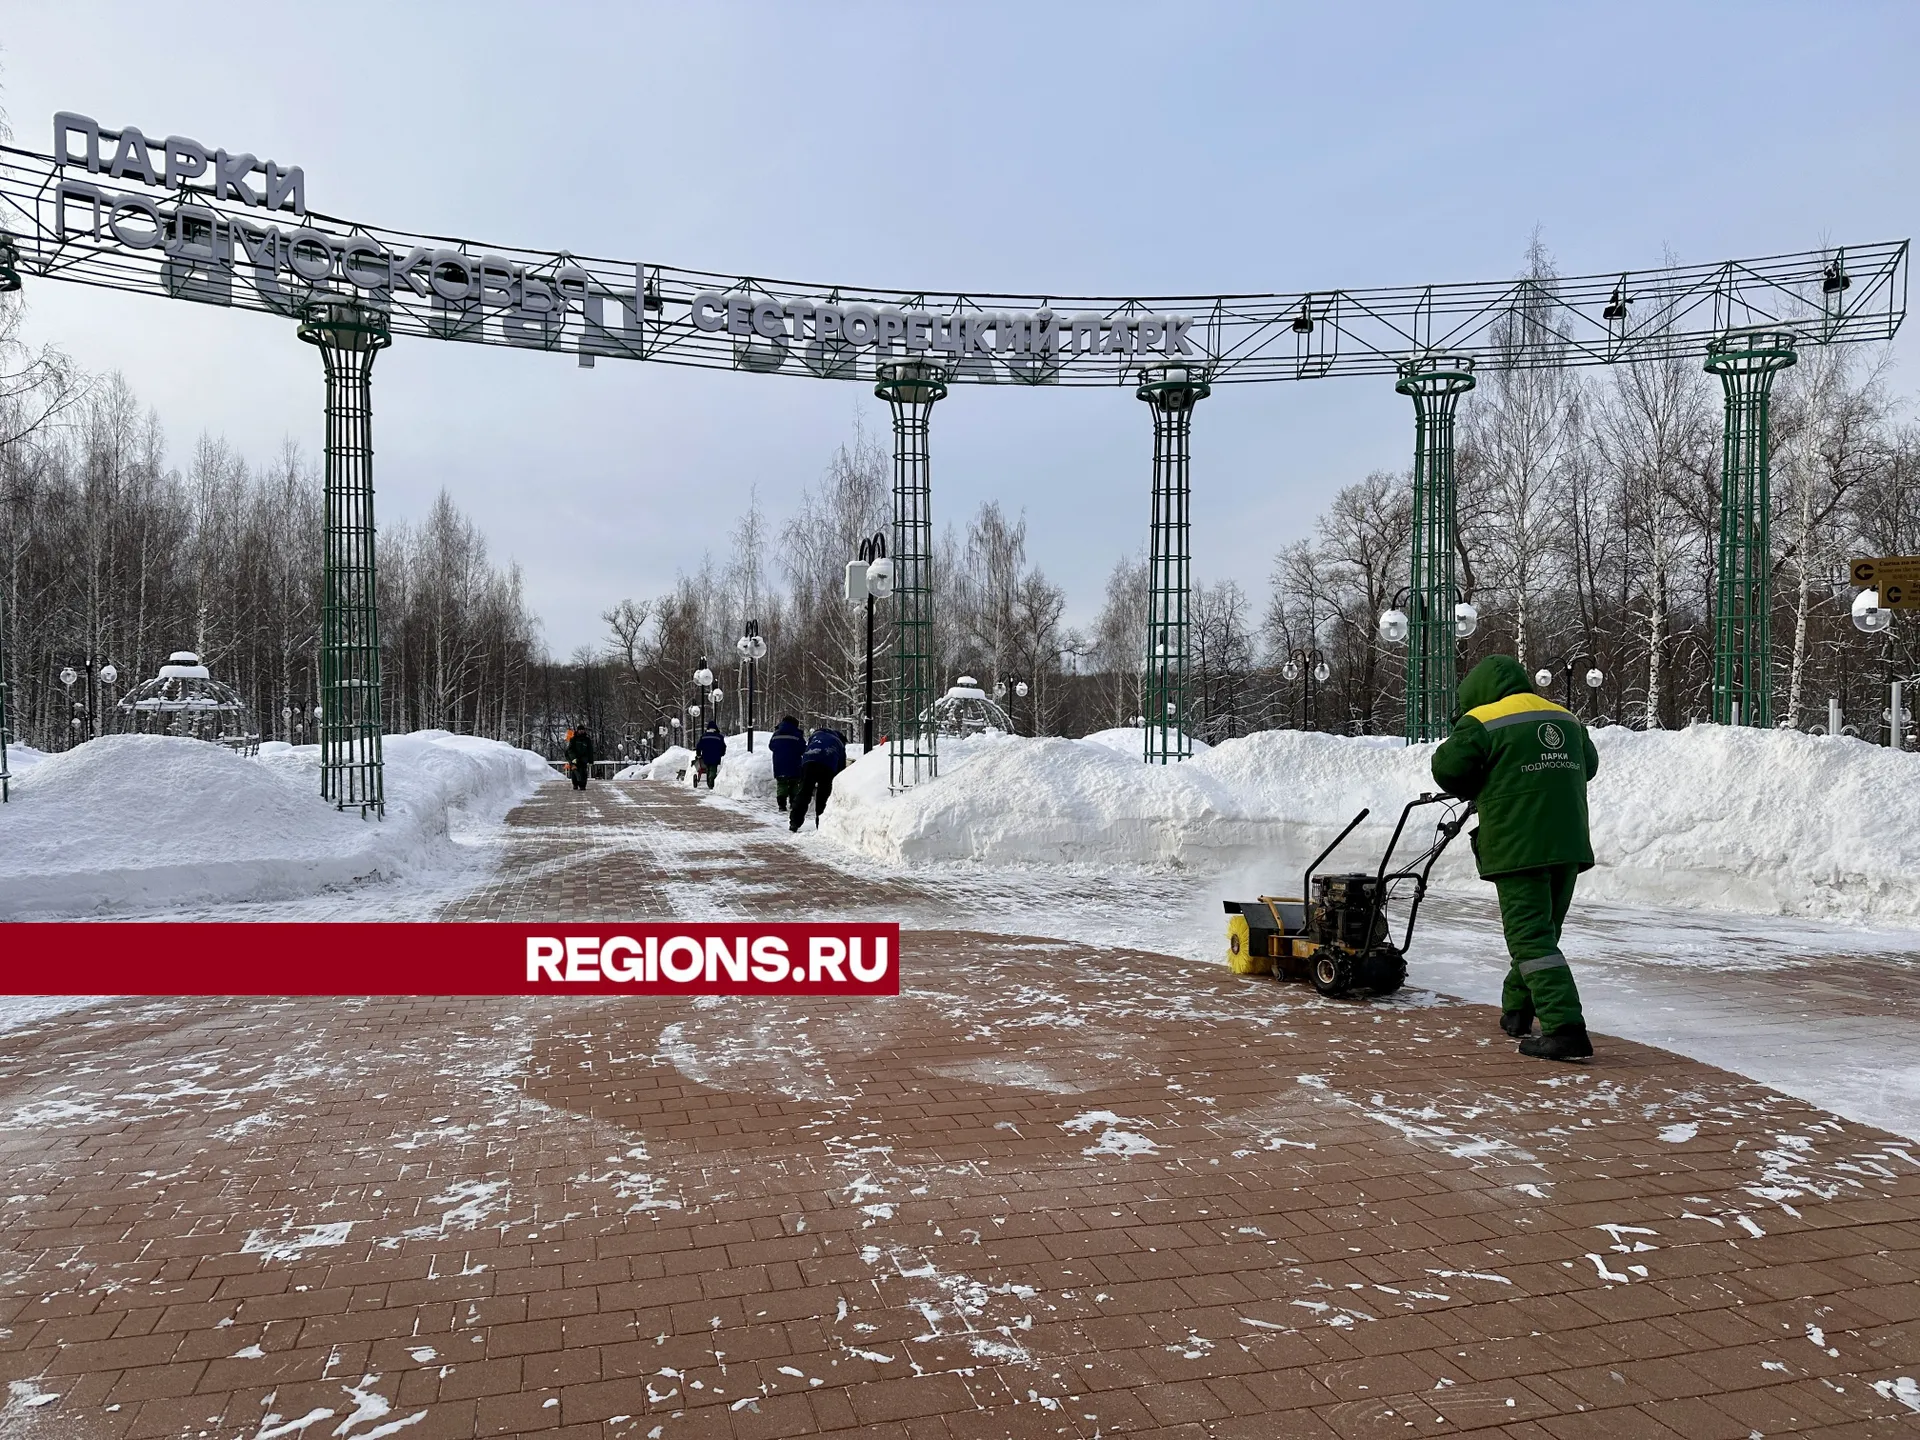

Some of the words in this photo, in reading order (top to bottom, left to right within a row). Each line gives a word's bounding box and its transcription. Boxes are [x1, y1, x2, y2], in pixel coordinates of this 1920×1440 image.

[53, 113, 306, 215] ПАРКИ
[55, 183, 590, 317] ПОДМОСКОВЬЯ
[691, 294, 1059, 356] СЕСТРОРЕЦКИЙ
[1070, 315, 1195, 356] ПАРК
[1540, 752, 1569, 761] ПАРКИ
